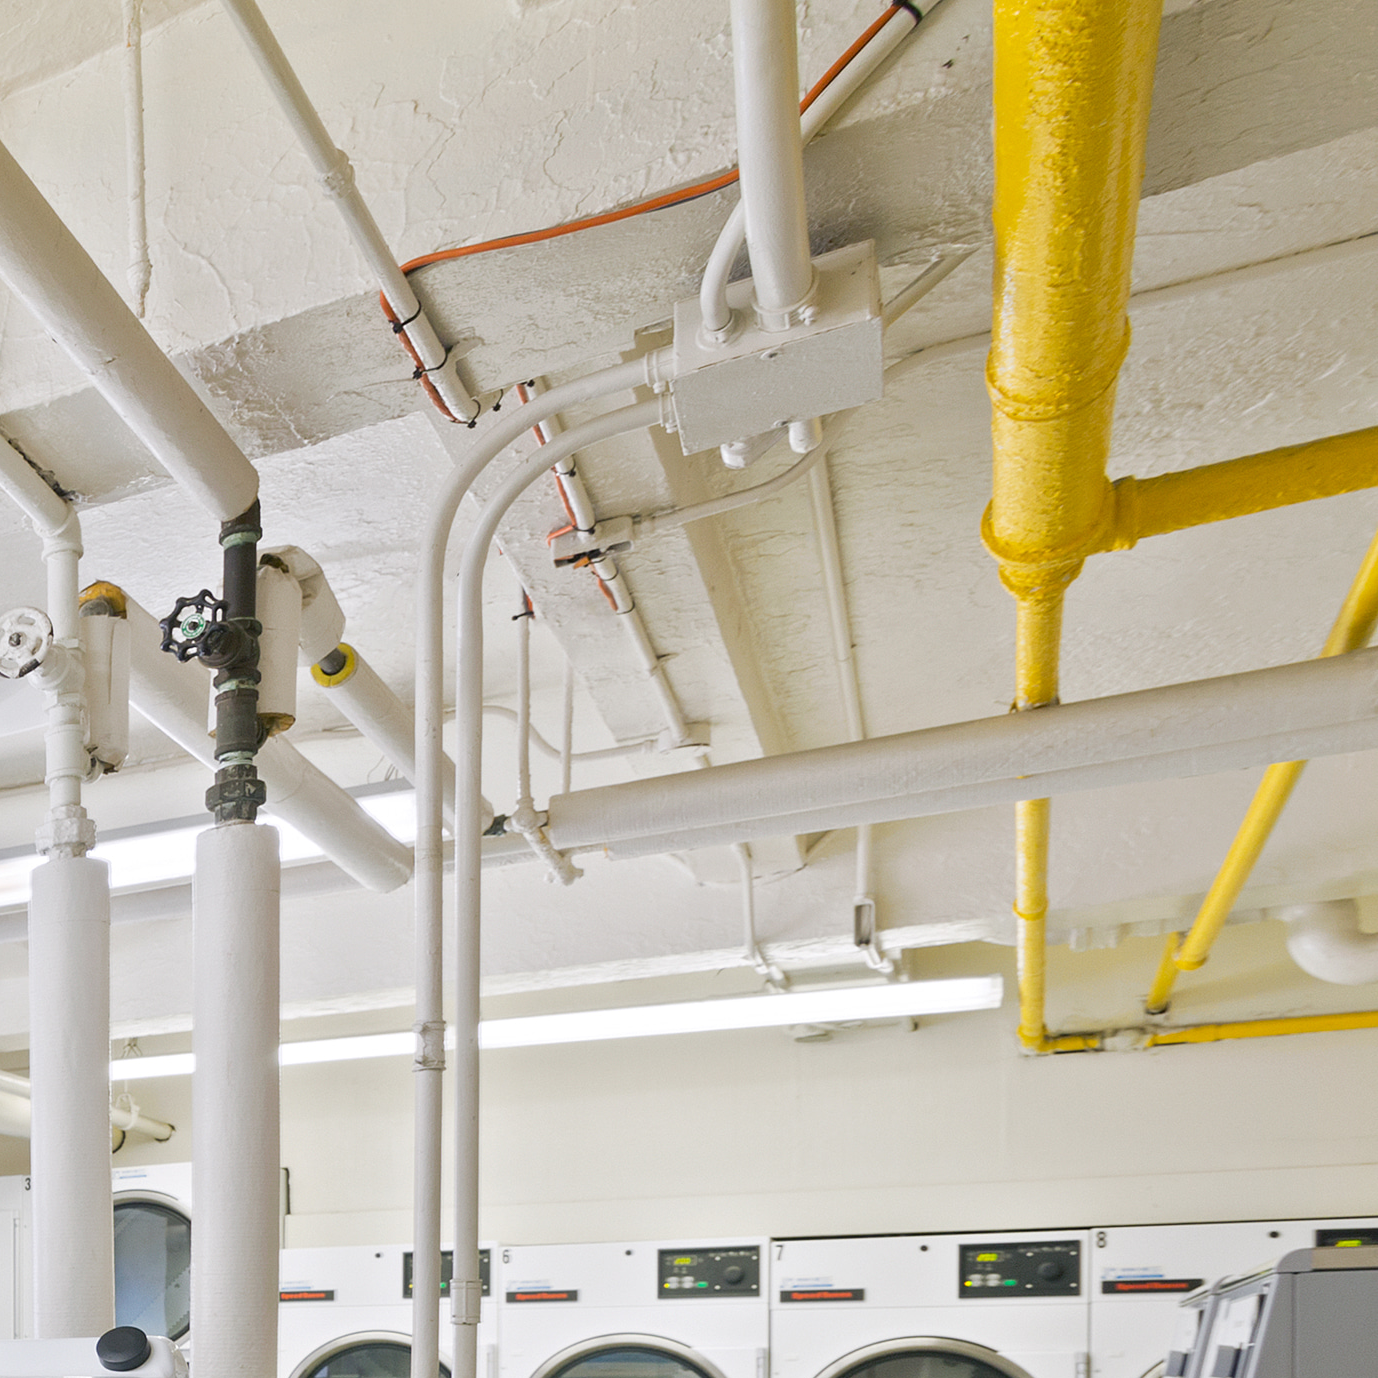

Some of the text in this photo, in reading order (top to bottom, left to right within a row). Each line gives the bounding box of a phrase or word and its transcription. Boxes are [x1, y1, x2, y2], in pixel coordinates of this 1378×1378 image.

[24, 1177, 32, 1191] 3
[1096, 1231, 1107, 1248] 8
[502, 1249, 510, 1264] 6
[775, 1244, 784, 1261] 7
